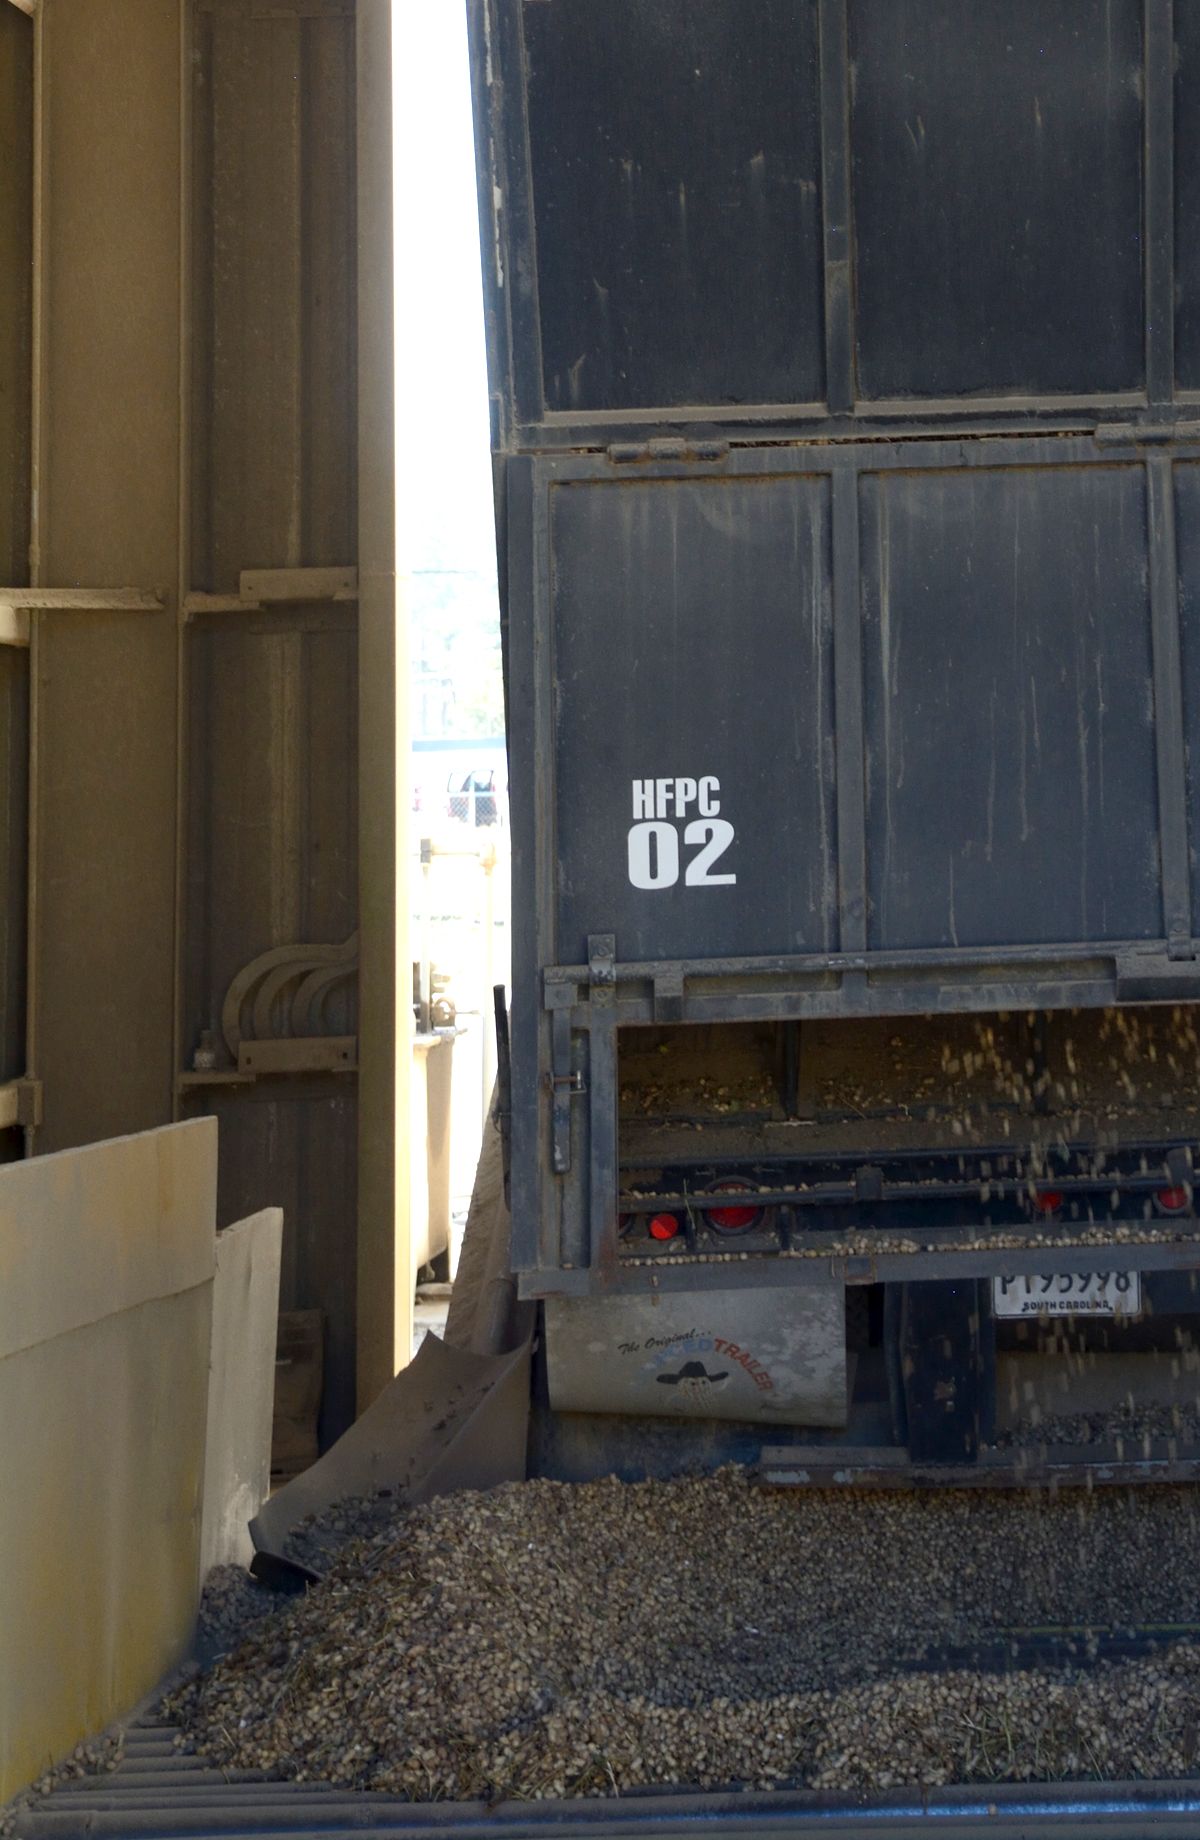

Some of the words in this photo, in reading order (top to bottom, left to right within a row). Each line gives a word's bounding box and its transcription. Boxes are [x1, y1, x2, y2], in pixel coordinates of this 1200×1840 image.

[632, 776, 721, 819] HFPC
[628, 818, 737, 890] 02
[1023, 1301, 1057, 1311] SOUTH
[1059, 1300, 1110, 1311] CAROLNA
[617, 1342, 641, 1356] The
[714, 1337, 774, 1392] TRAILER
